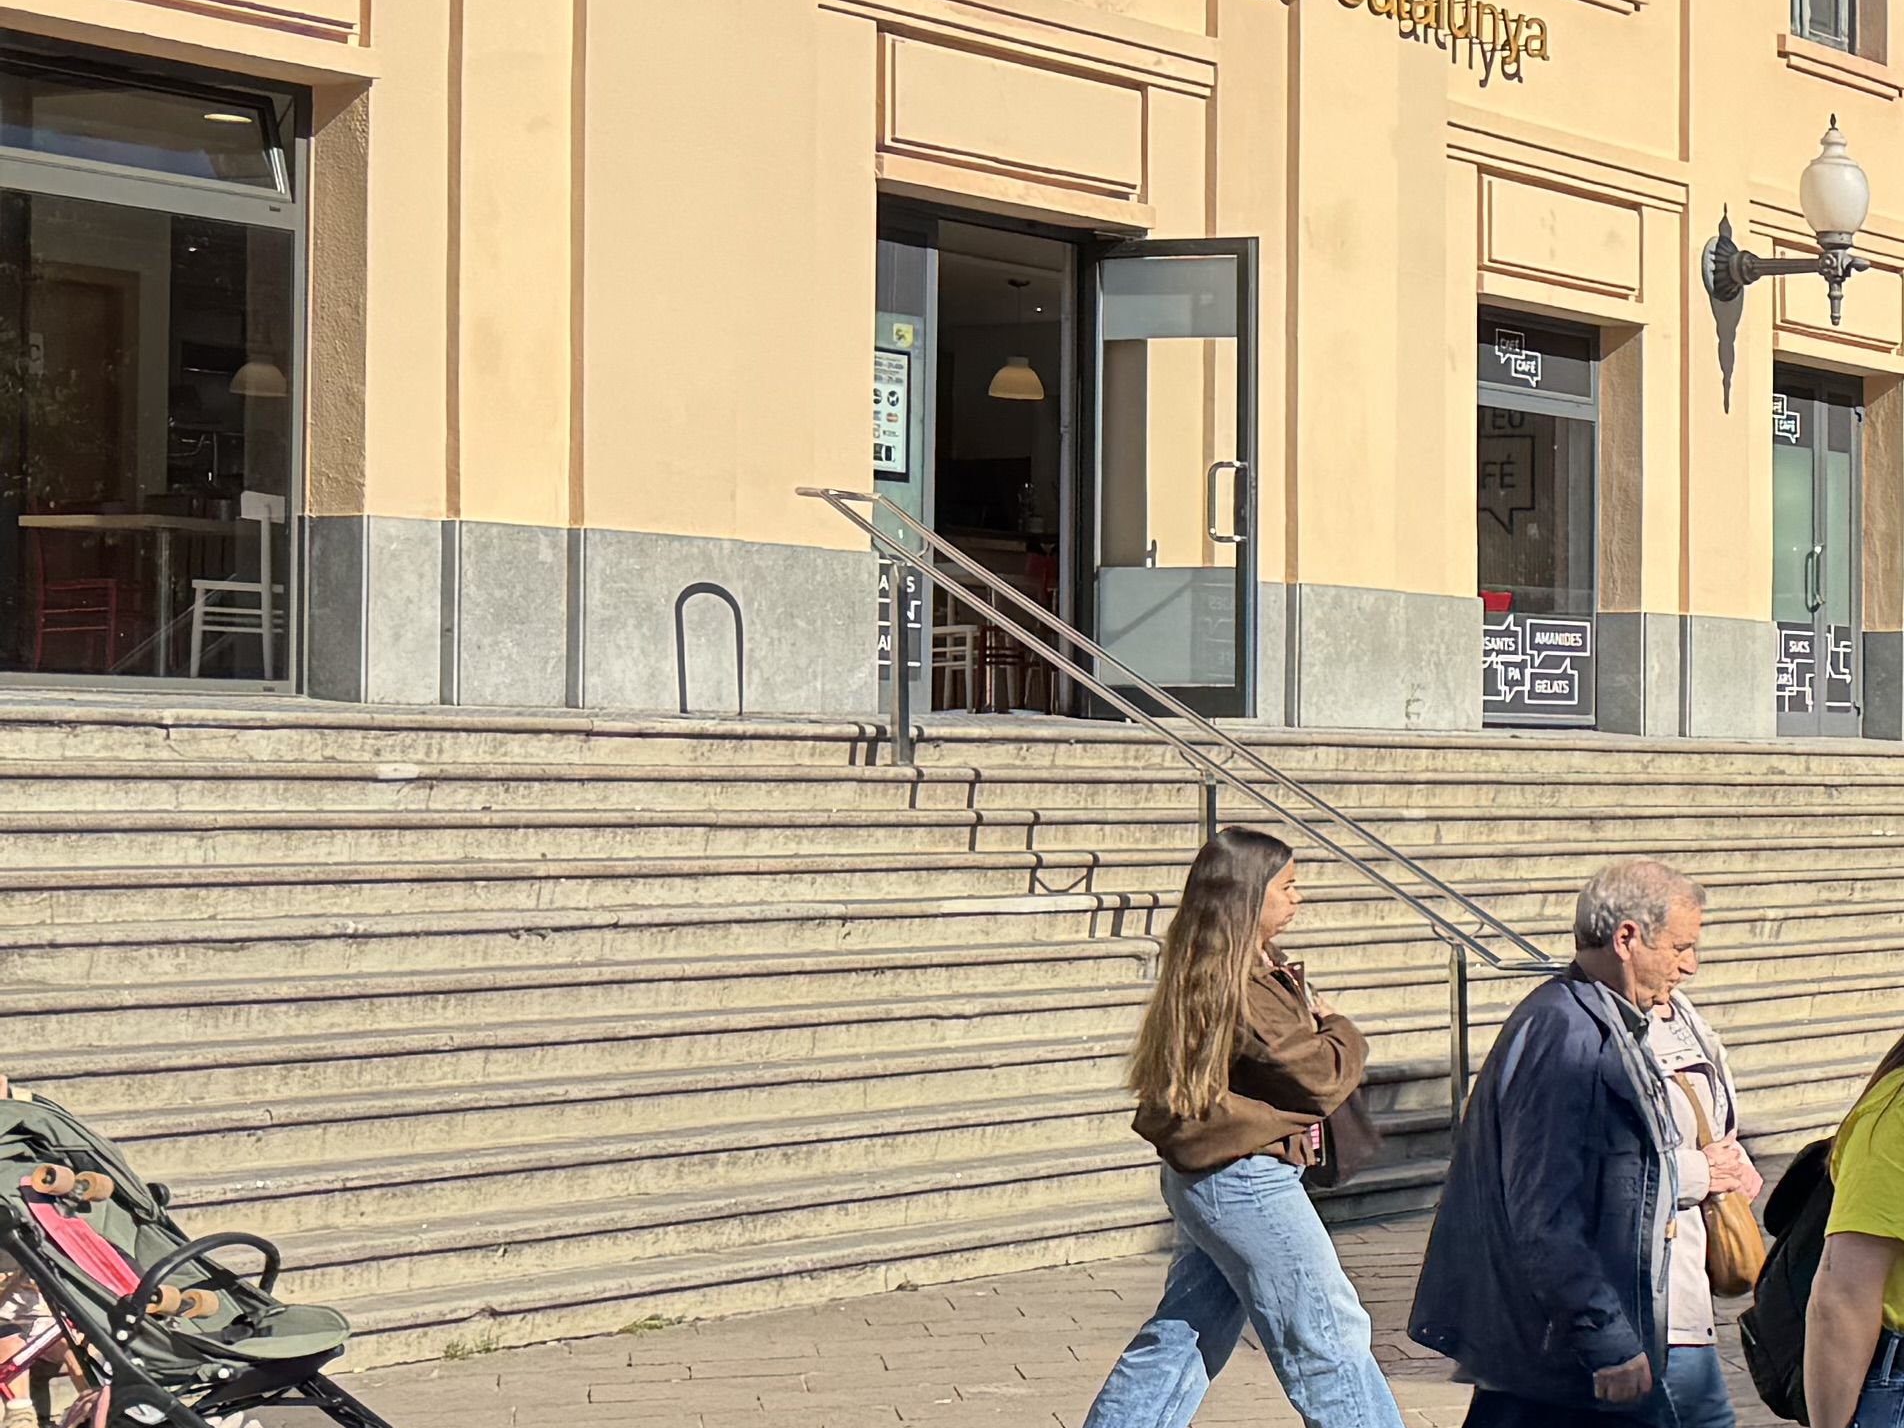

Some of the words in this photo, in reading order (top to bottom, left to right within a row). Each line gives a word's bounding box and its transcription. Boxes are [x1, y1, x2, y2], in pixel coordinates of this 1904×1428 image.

[1534, 632, 1583, 647] AMANIDES
[1508, 667, 1521, 681] PA
[1535, 679, 1570, 694] GELATS
